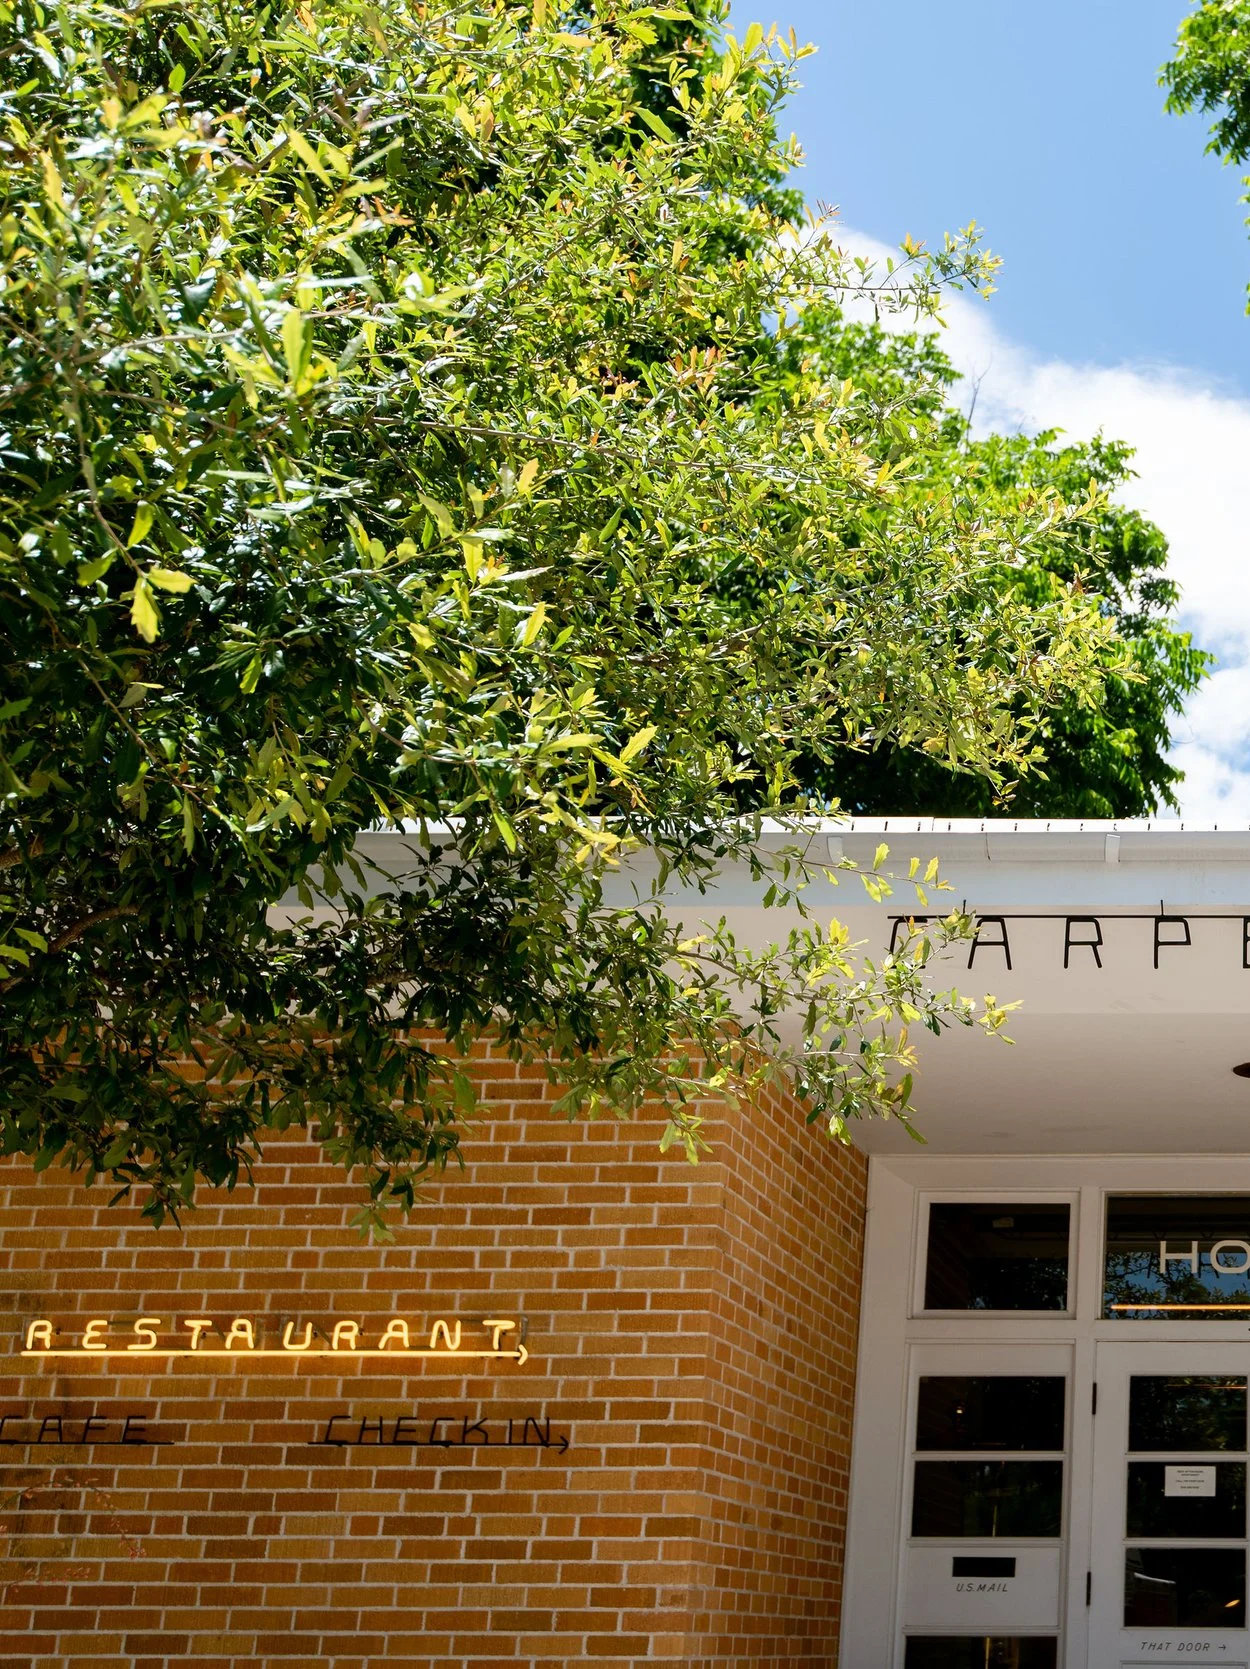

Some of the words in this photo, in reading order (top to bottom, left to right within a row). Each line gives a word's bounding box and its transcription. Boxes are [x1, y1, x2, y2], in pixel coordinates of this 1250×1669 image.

[26, 1318, 518, 1351] RESTAURANT
[0, 1415, 147, 1444] CAFE
[1141, 1642, 1171, 1651] THAT
[1177, 1642, 1210, 1652] DOOR
